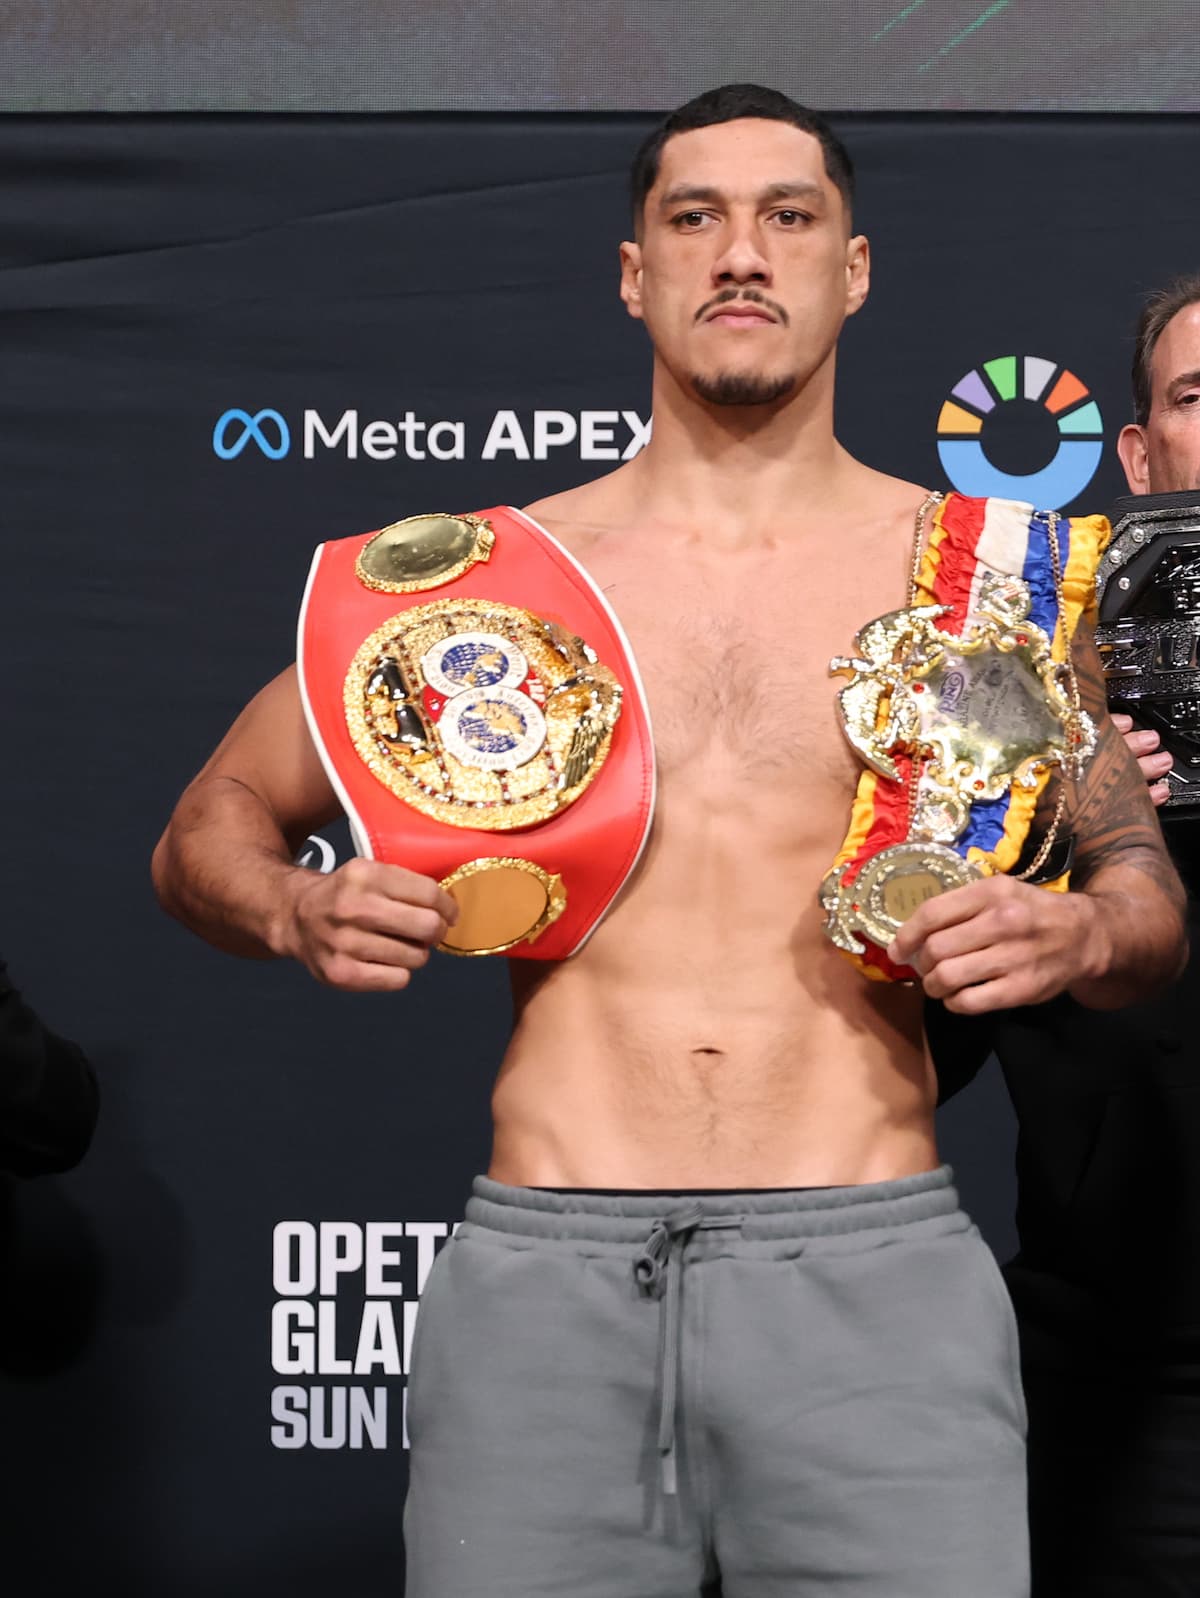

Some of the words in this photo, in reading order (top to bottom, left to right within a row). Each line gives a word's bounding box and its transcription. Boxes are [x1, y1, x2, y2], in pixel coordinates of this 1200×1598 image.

[303, 409, 465, 461] Meta
[481, 410, 654, 460] APEX
[273, 1221, 461, 1296] OPET
[271, 1385, 387, 1449] SUN
